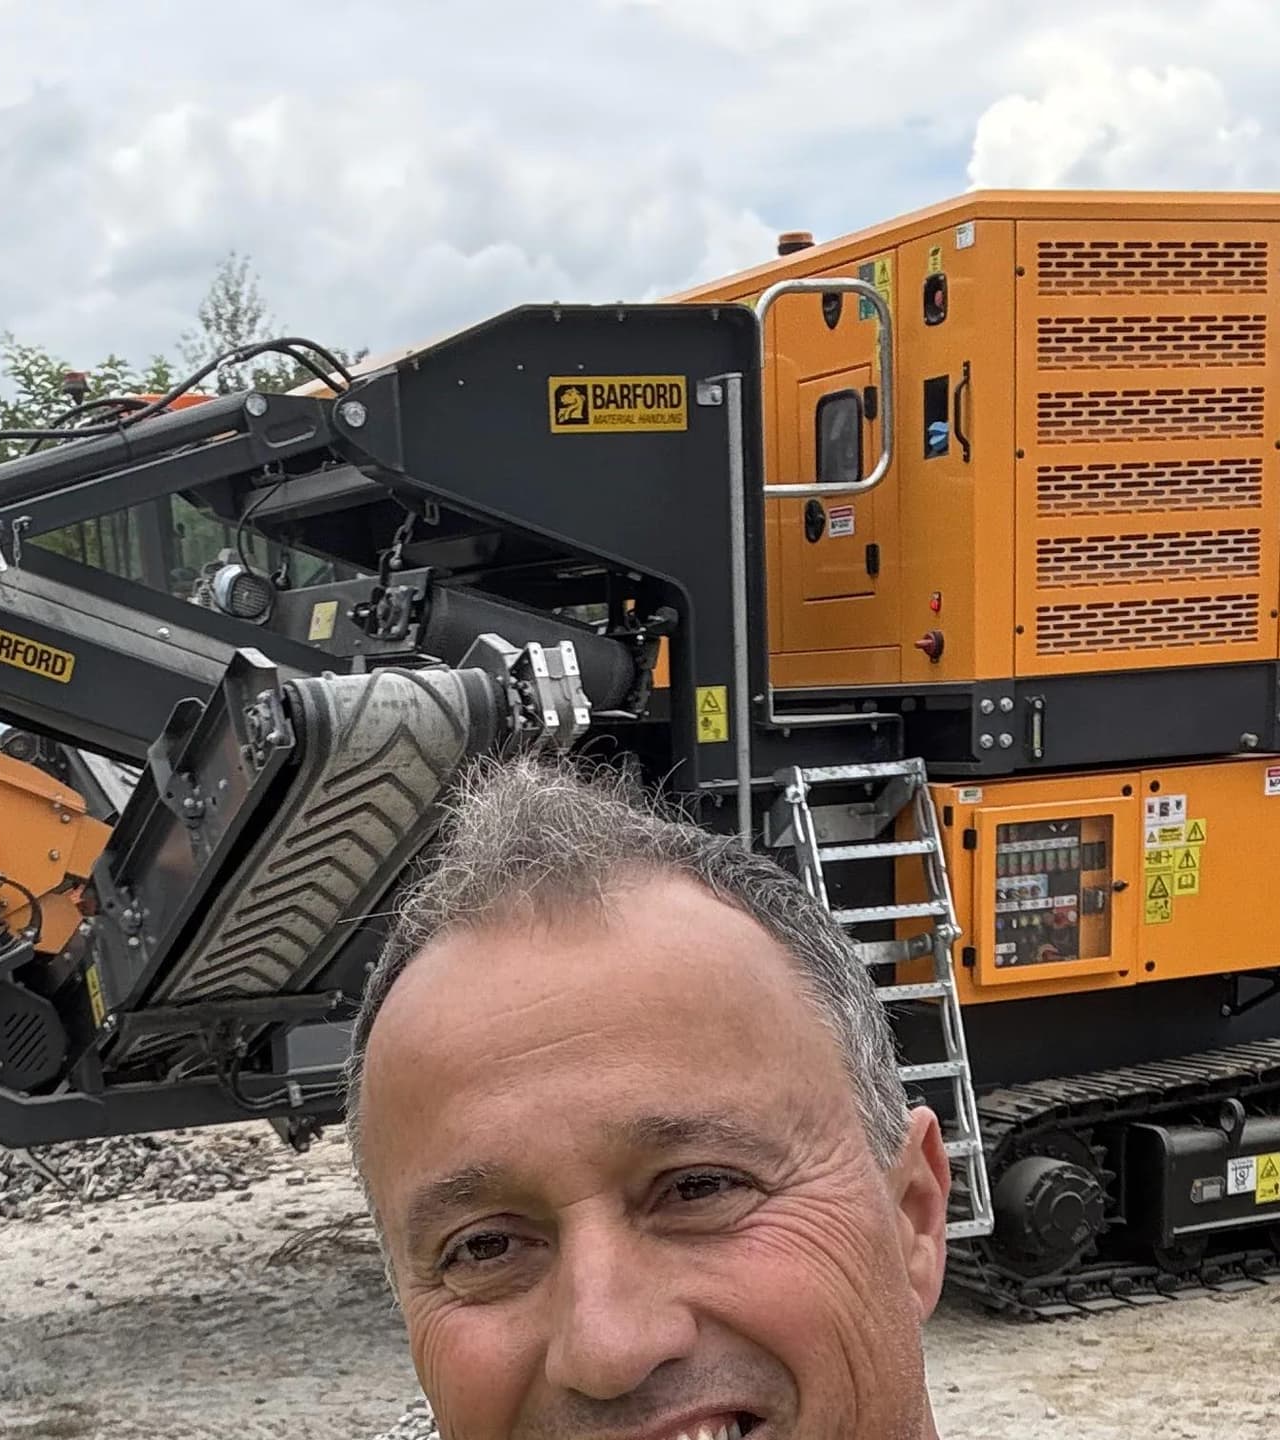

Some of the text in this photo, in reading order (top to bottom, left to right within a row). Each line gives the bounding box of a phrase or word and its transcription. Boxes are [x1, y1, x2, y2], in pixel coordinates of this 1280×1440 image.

[592, 383, 682, 409] BARFORD
[593, 413, 682, 425] MATERIAL HANDLING
